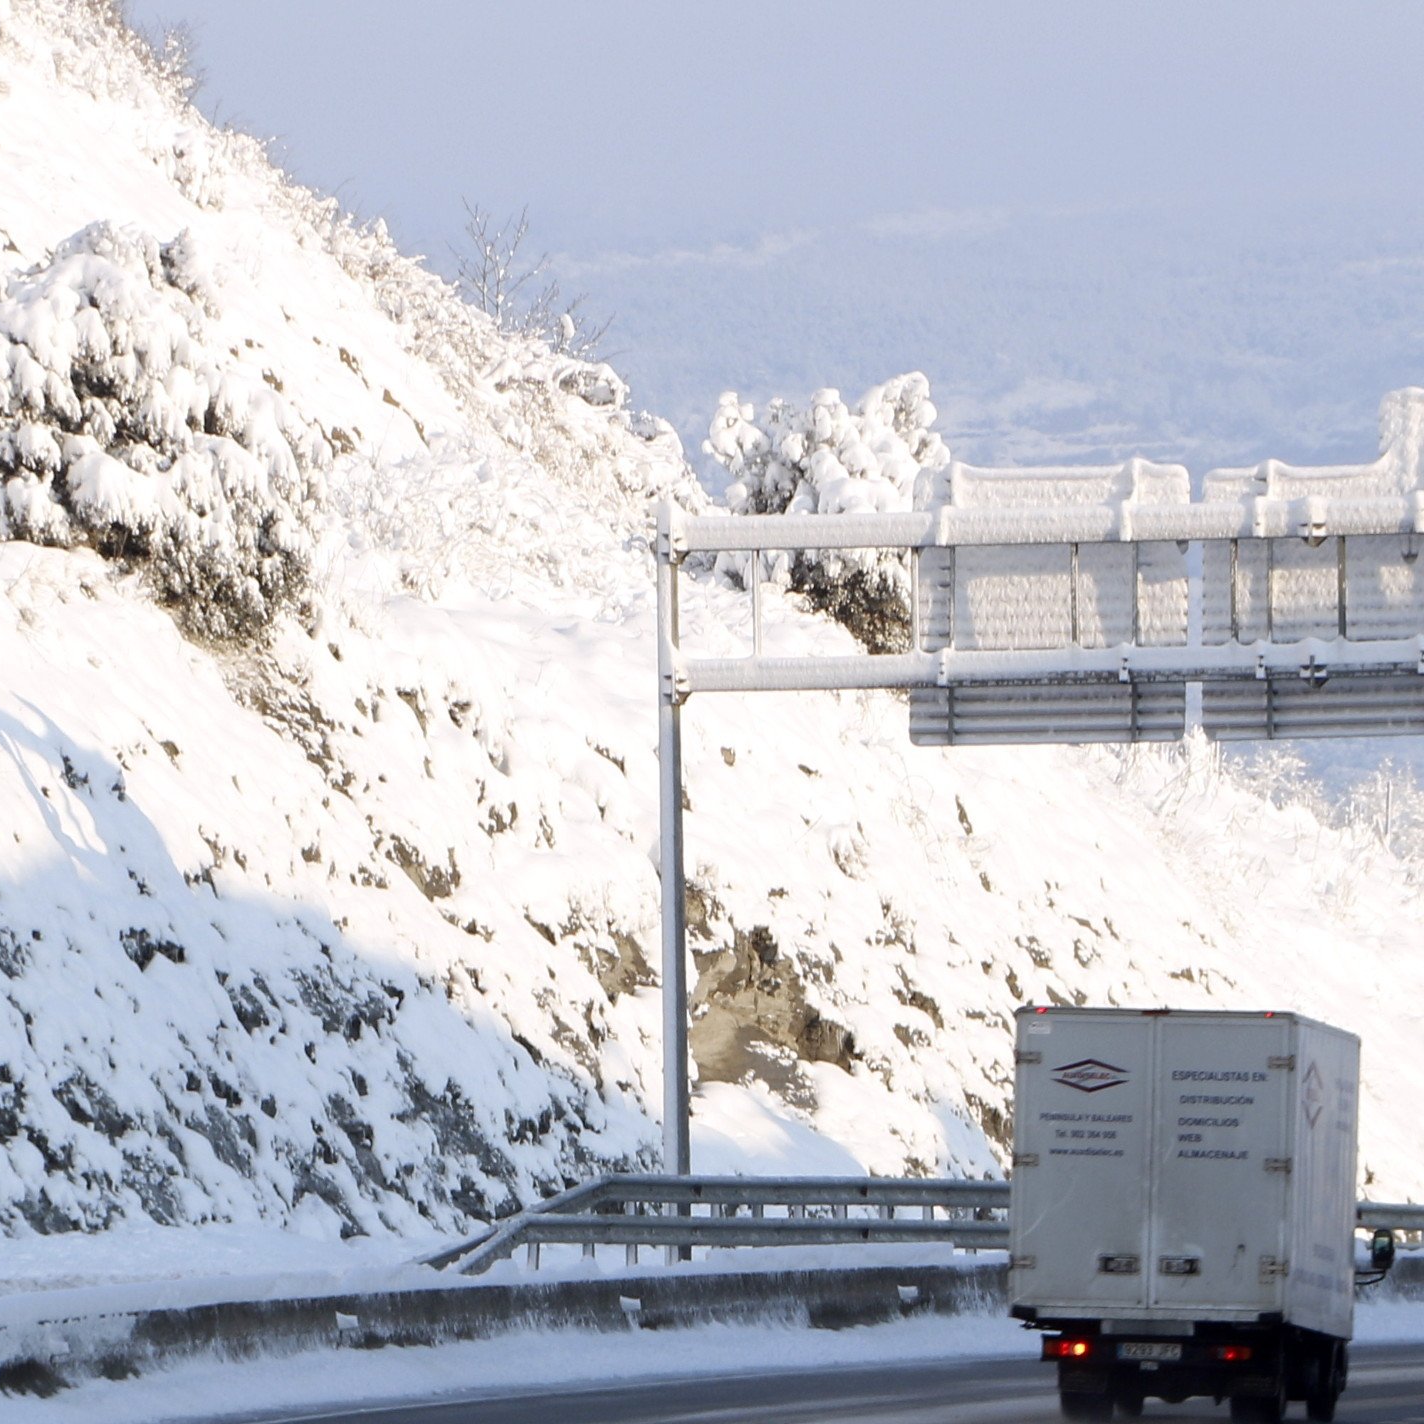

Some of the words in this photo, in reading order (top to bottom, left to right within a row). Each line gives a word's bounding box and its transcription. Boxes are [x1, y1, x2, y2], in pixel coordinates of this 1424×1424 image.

[1171, 1070, 1250, 1082] ESPECIALISTAS
[1178, 1117, 1240, 1128] DOMICILIOS
[1178, 1133, 1202, 1142] WEB
[1177, 1150, 1249, 1160] ALMACENAJE
